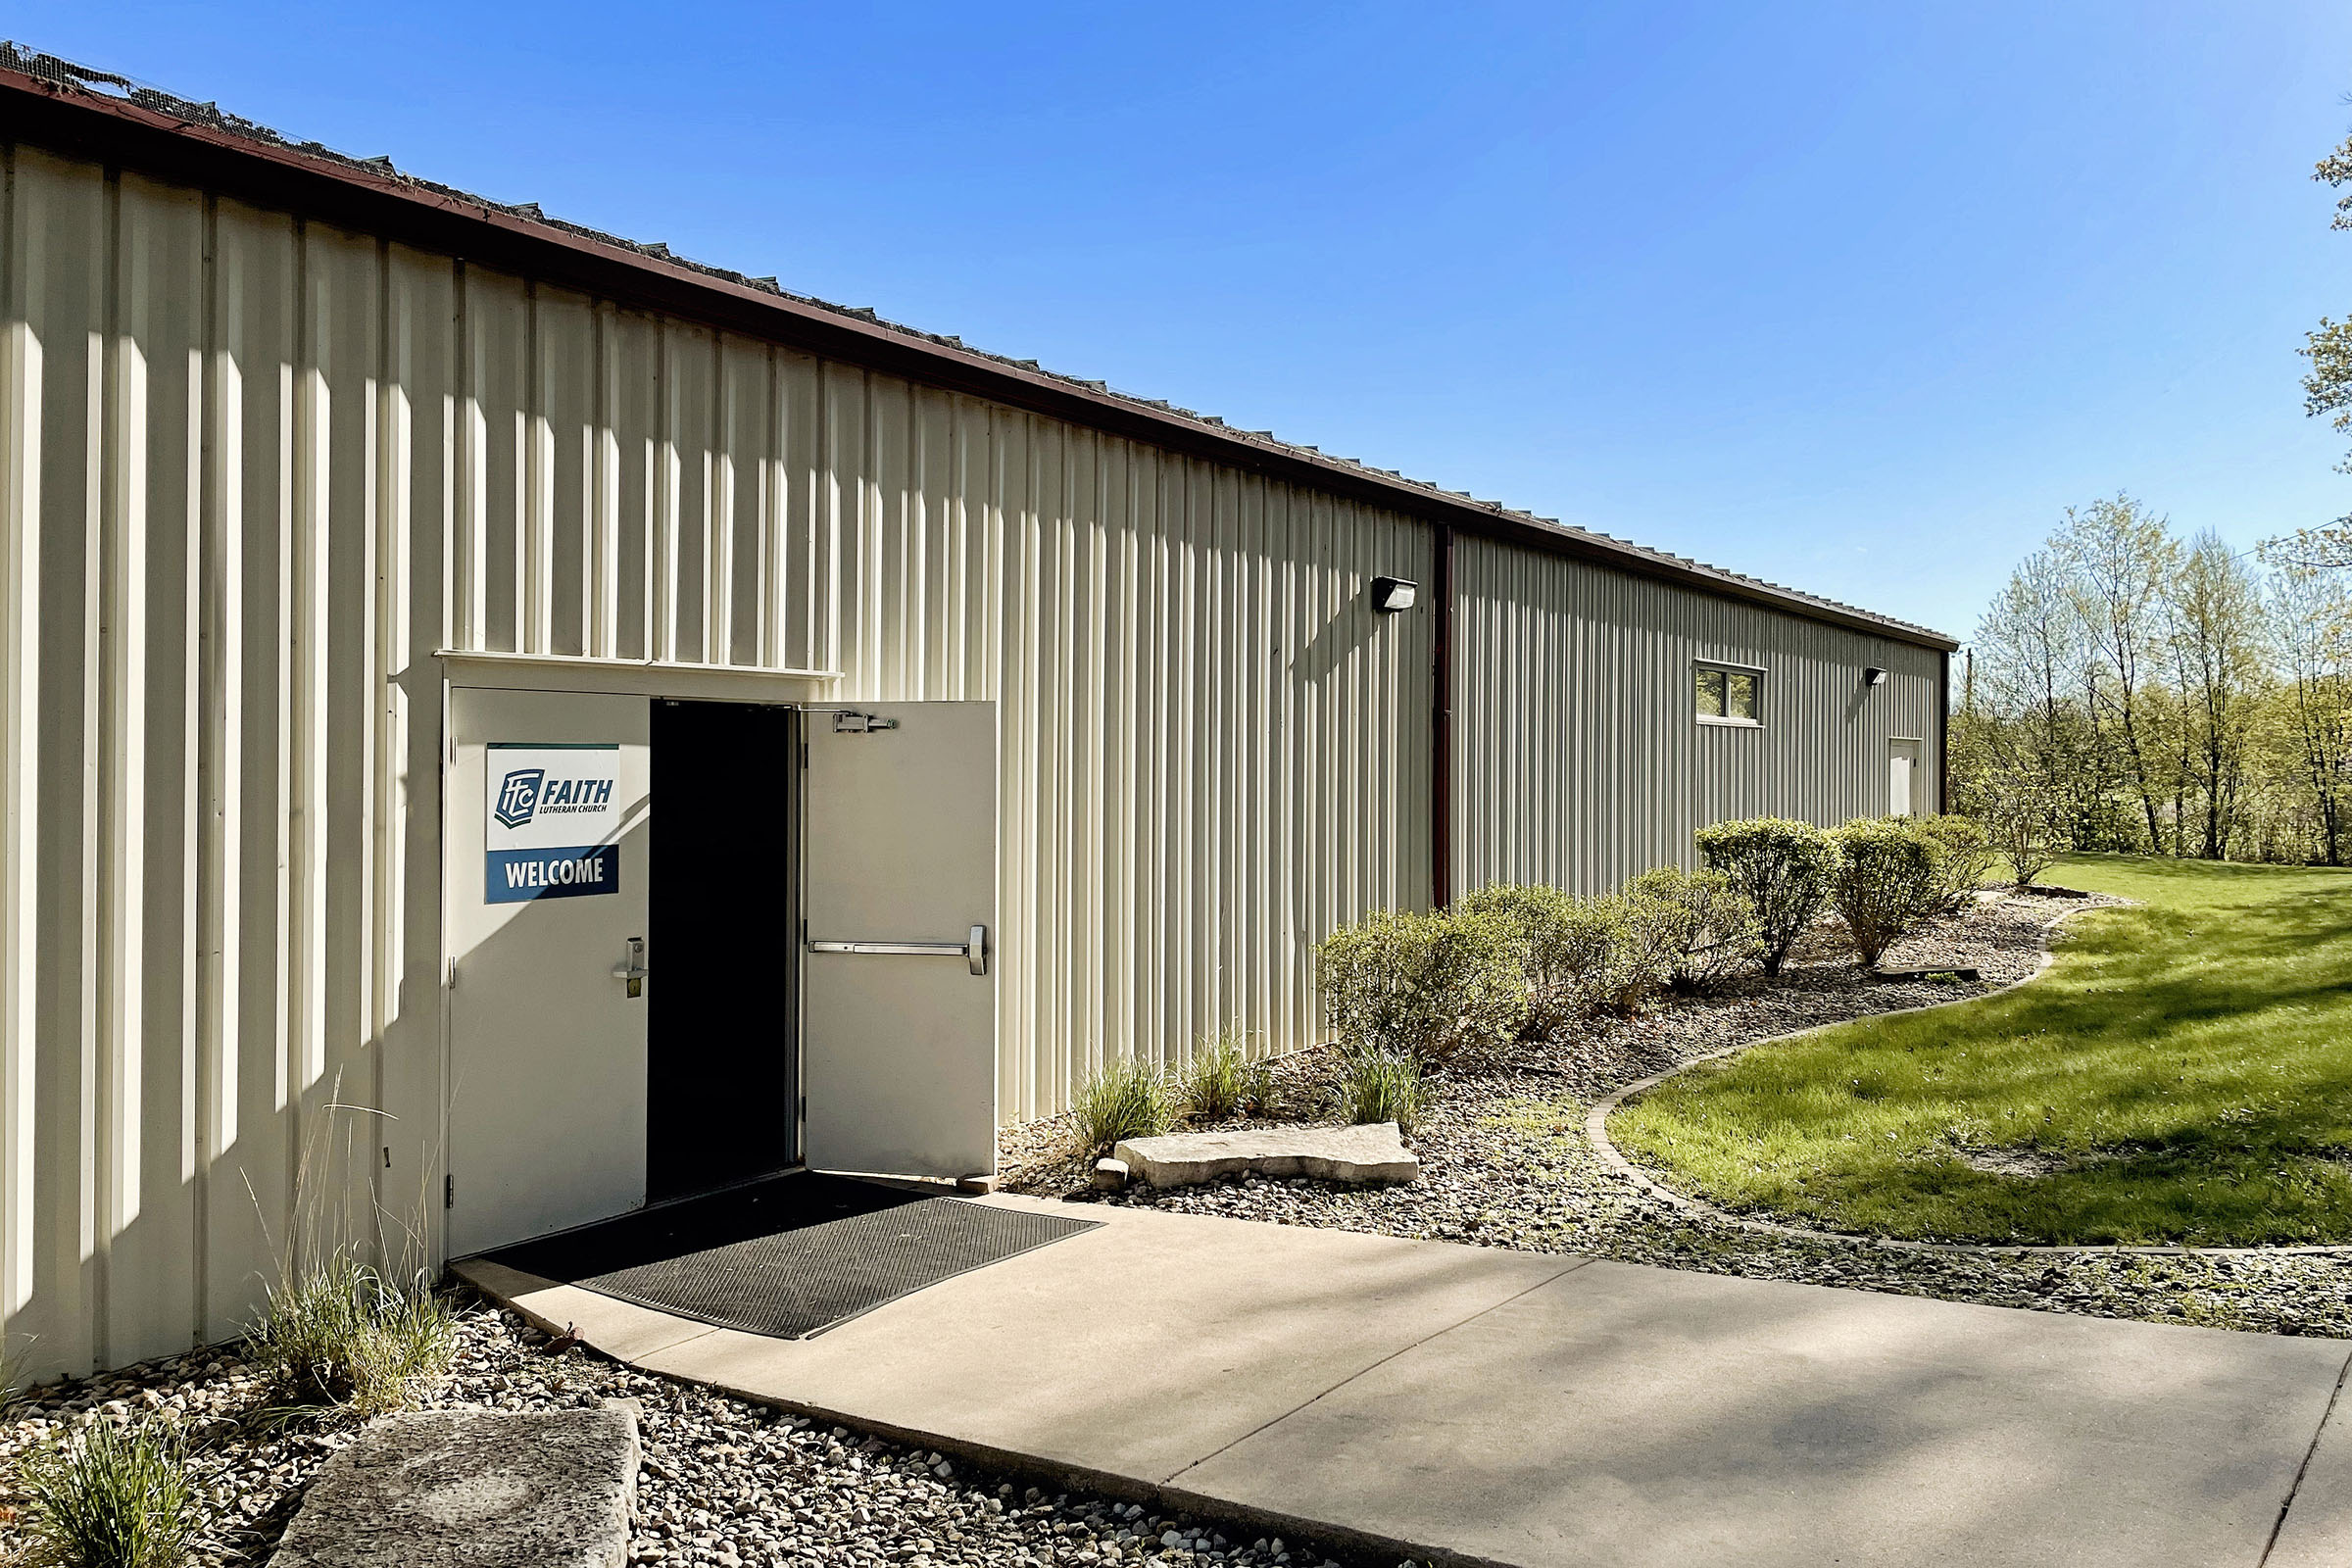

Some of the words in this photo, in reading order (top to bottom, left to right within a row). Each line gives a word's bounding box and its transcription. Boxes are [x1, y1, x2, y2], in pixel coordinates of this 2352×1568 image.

[542, 779, 613, 805] FAITH
[539, 806, 577, 814] LUTHERAN
[578, 805, 607, 813] CHURCH
[505, 858, 604, 889] WELCOME
